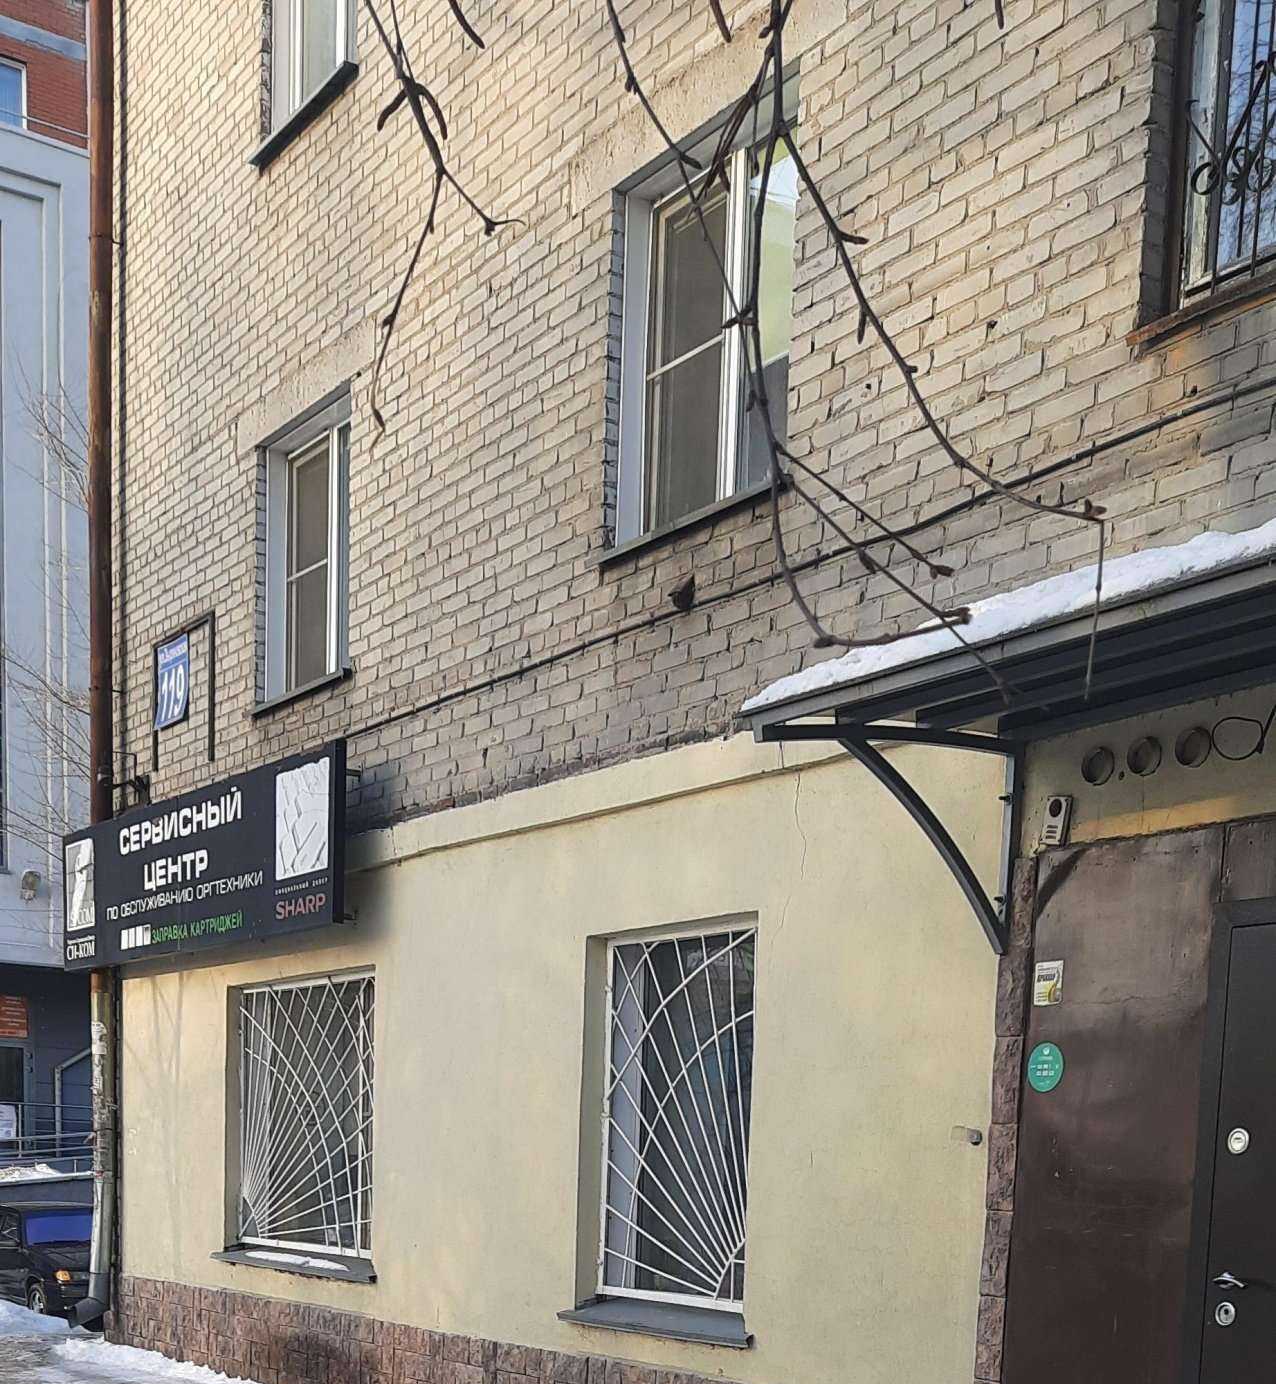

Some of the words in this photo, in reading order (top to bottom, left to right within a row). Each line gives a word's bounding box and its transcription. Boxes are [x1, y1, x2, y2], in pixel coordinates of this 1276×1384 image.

[161, 664, 185, 722] 119
[119, 786, 243, 856] СЕРВИСНЫЙ
[143, 849, 208, 892] ЦЕНТР
[106, 905, 119, 921] ПО
[120, 886, 194, 918] ОБСЛУЖИВАНИЮ
[196, 870, 264, 900] ОРГТЕХНИКИ
[275, 893, 326, 920] SHARP
[151, 923, 189, 945] ЗАПРАВКА
[190, 909, 243, 939] КАРТРИДЖЕЙ
